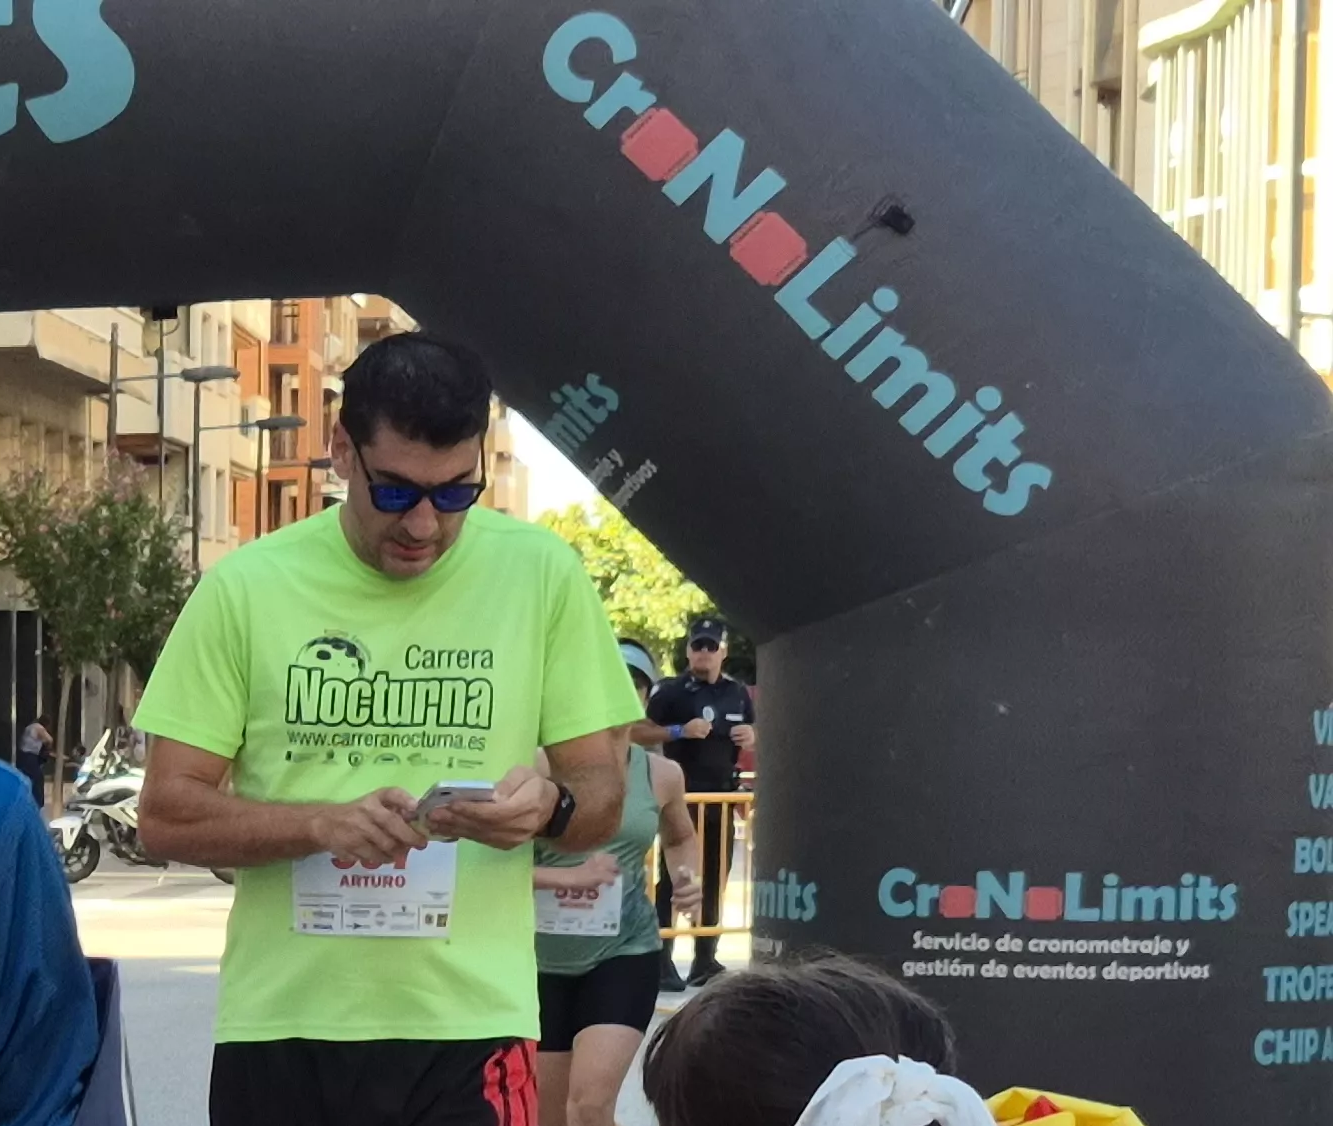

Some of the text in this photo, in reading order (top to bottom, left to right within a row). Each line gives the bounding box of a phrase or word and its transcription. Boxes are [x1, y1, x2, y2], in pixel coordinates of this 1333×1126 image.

[405, 644, 493, 670] Carrera
[285, 664, 493, 729] Nocturna
[340, 874, 406, 889] ARTURO
[913, 931, 1190, 957] Servicio de cronometraje y
[902, 957, 1210, 981] gestión de eventos deportivos
[1254, 1028, 1319, 1066] CHIP
